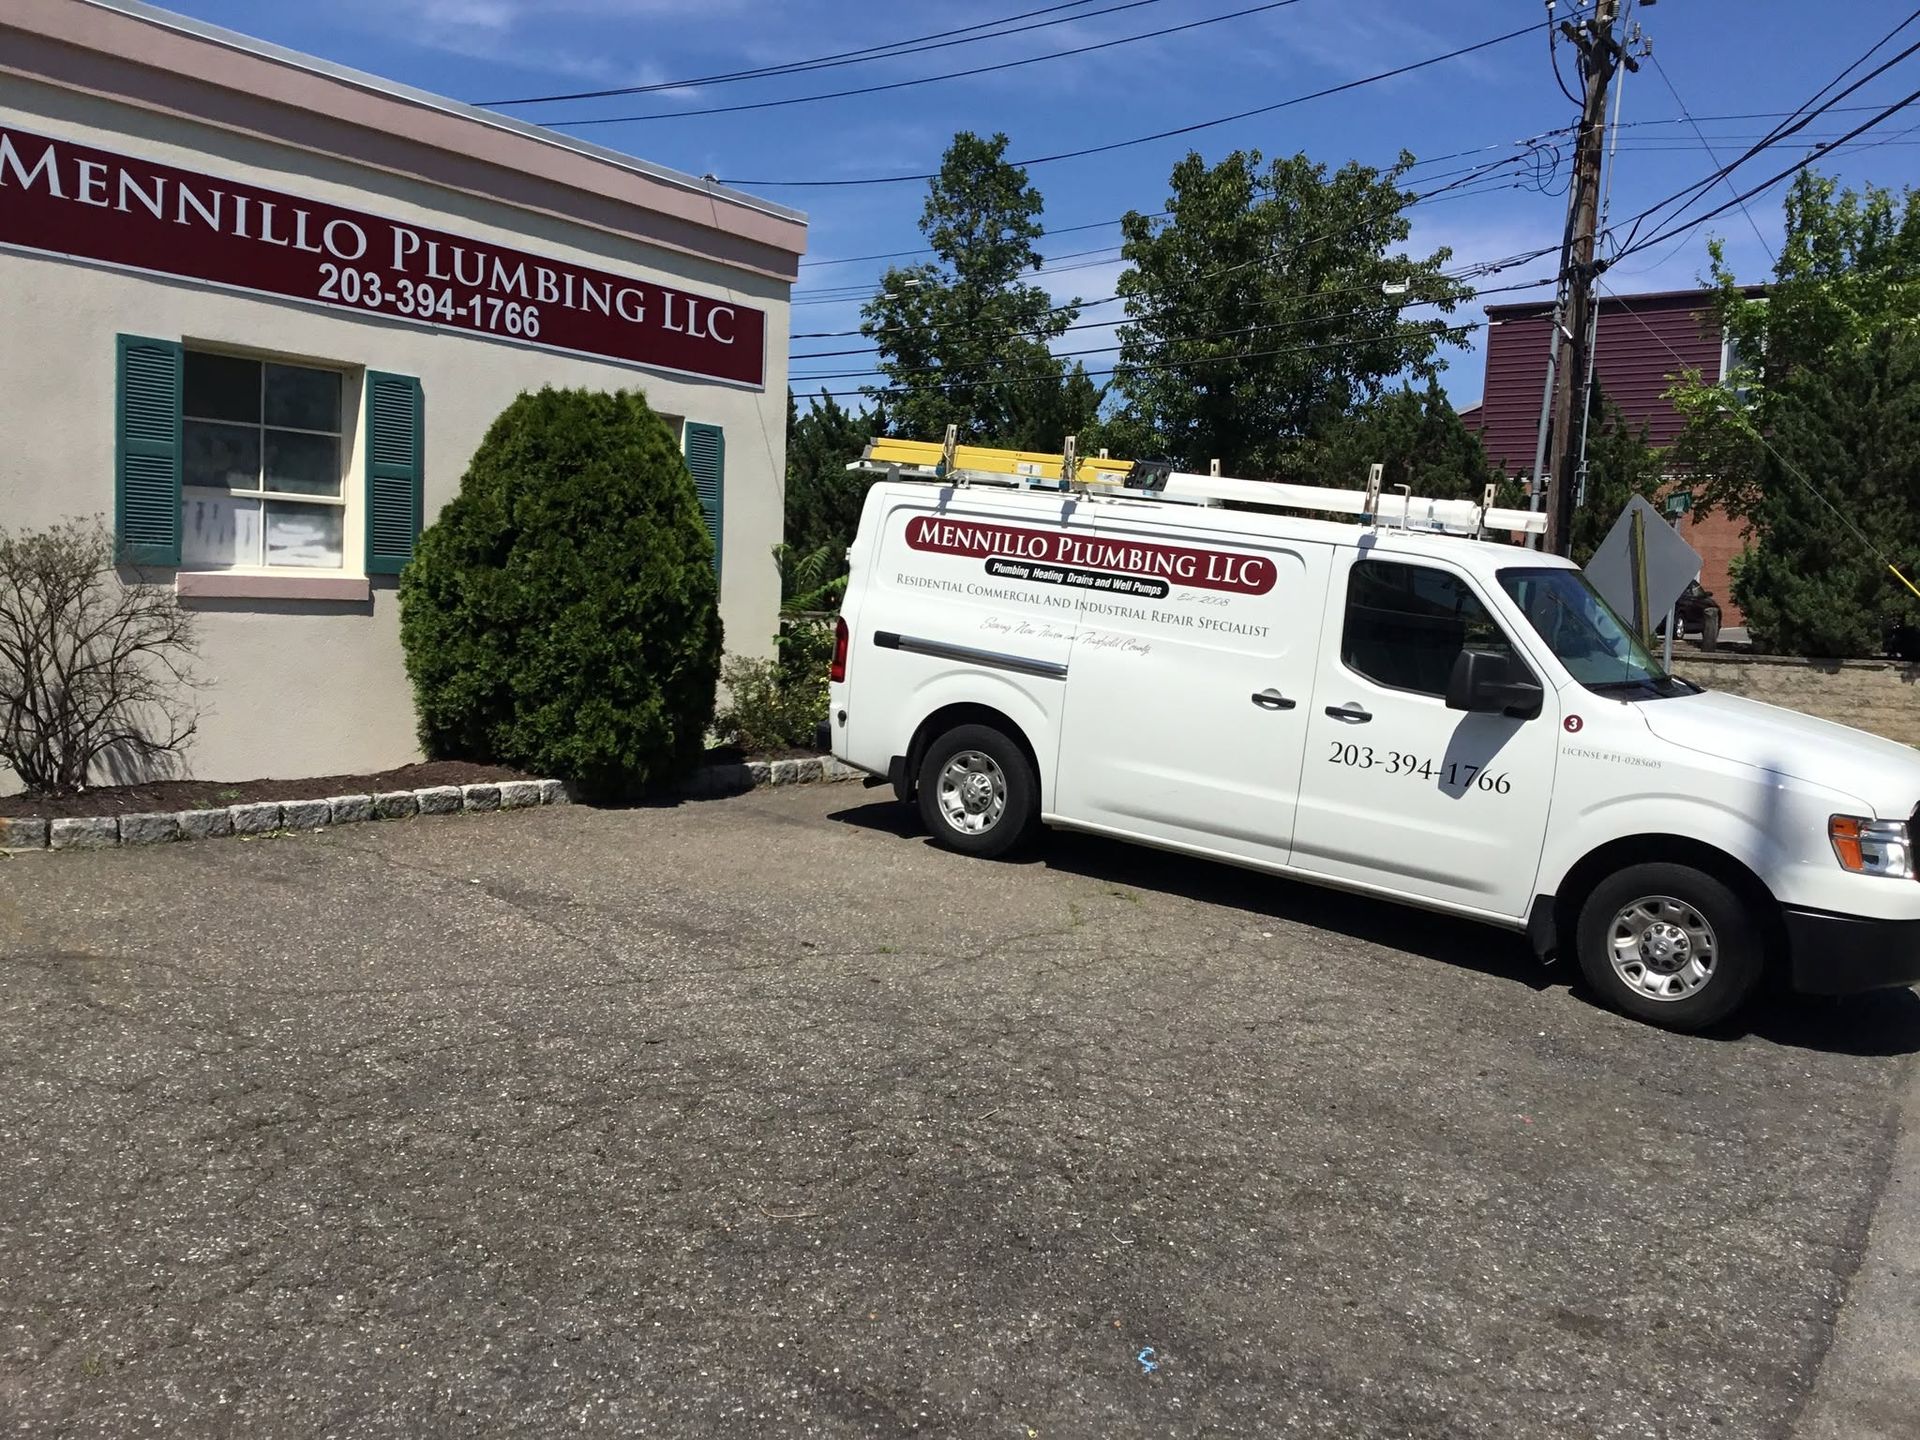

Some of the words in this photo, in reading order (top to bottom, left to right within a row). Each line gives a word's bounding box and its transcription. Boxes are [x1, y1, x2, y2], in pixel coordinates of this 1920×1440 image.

[0, 132, 367, 259] MENNILLO
[389, 225, 647, 323] PLUMBING
[661, 292, 736, 345] LLC
[318, 262, 540, 339] 203-394-1766
[917, 520, 1048, 558] MENNILLO
[1055, 537, 1197, 578] PLUMBING
[1205, 555, 1263, 587] LLC
[992, 562, 1029, 579] Plumbing
[1032, 567, 1064, 584] Heating
[1066, 572, 1094, 586] Drains
[1094, 577, 1111, 588] and
[1112, 579, 1132, 592] Well
[1132, 582, 1162, 595] Pumps
[896, 573, 964, 594] RESIDENTIAL
[966, 583, 1042, 606] COMMERCIAL
[1045, 594, 1071, 609] AND
[1074, 598, 1148, 621] INDUSTRIAL
[1151, 609, 1195, 628] REPAIR
[1197, 616, 1270, 638] SPECIALIST
[1568, 717, 1578, 730] 3
[1328, 742, 1511, 794] 203-394-1766
[1562, 746, 1602, 761] LICENSE
